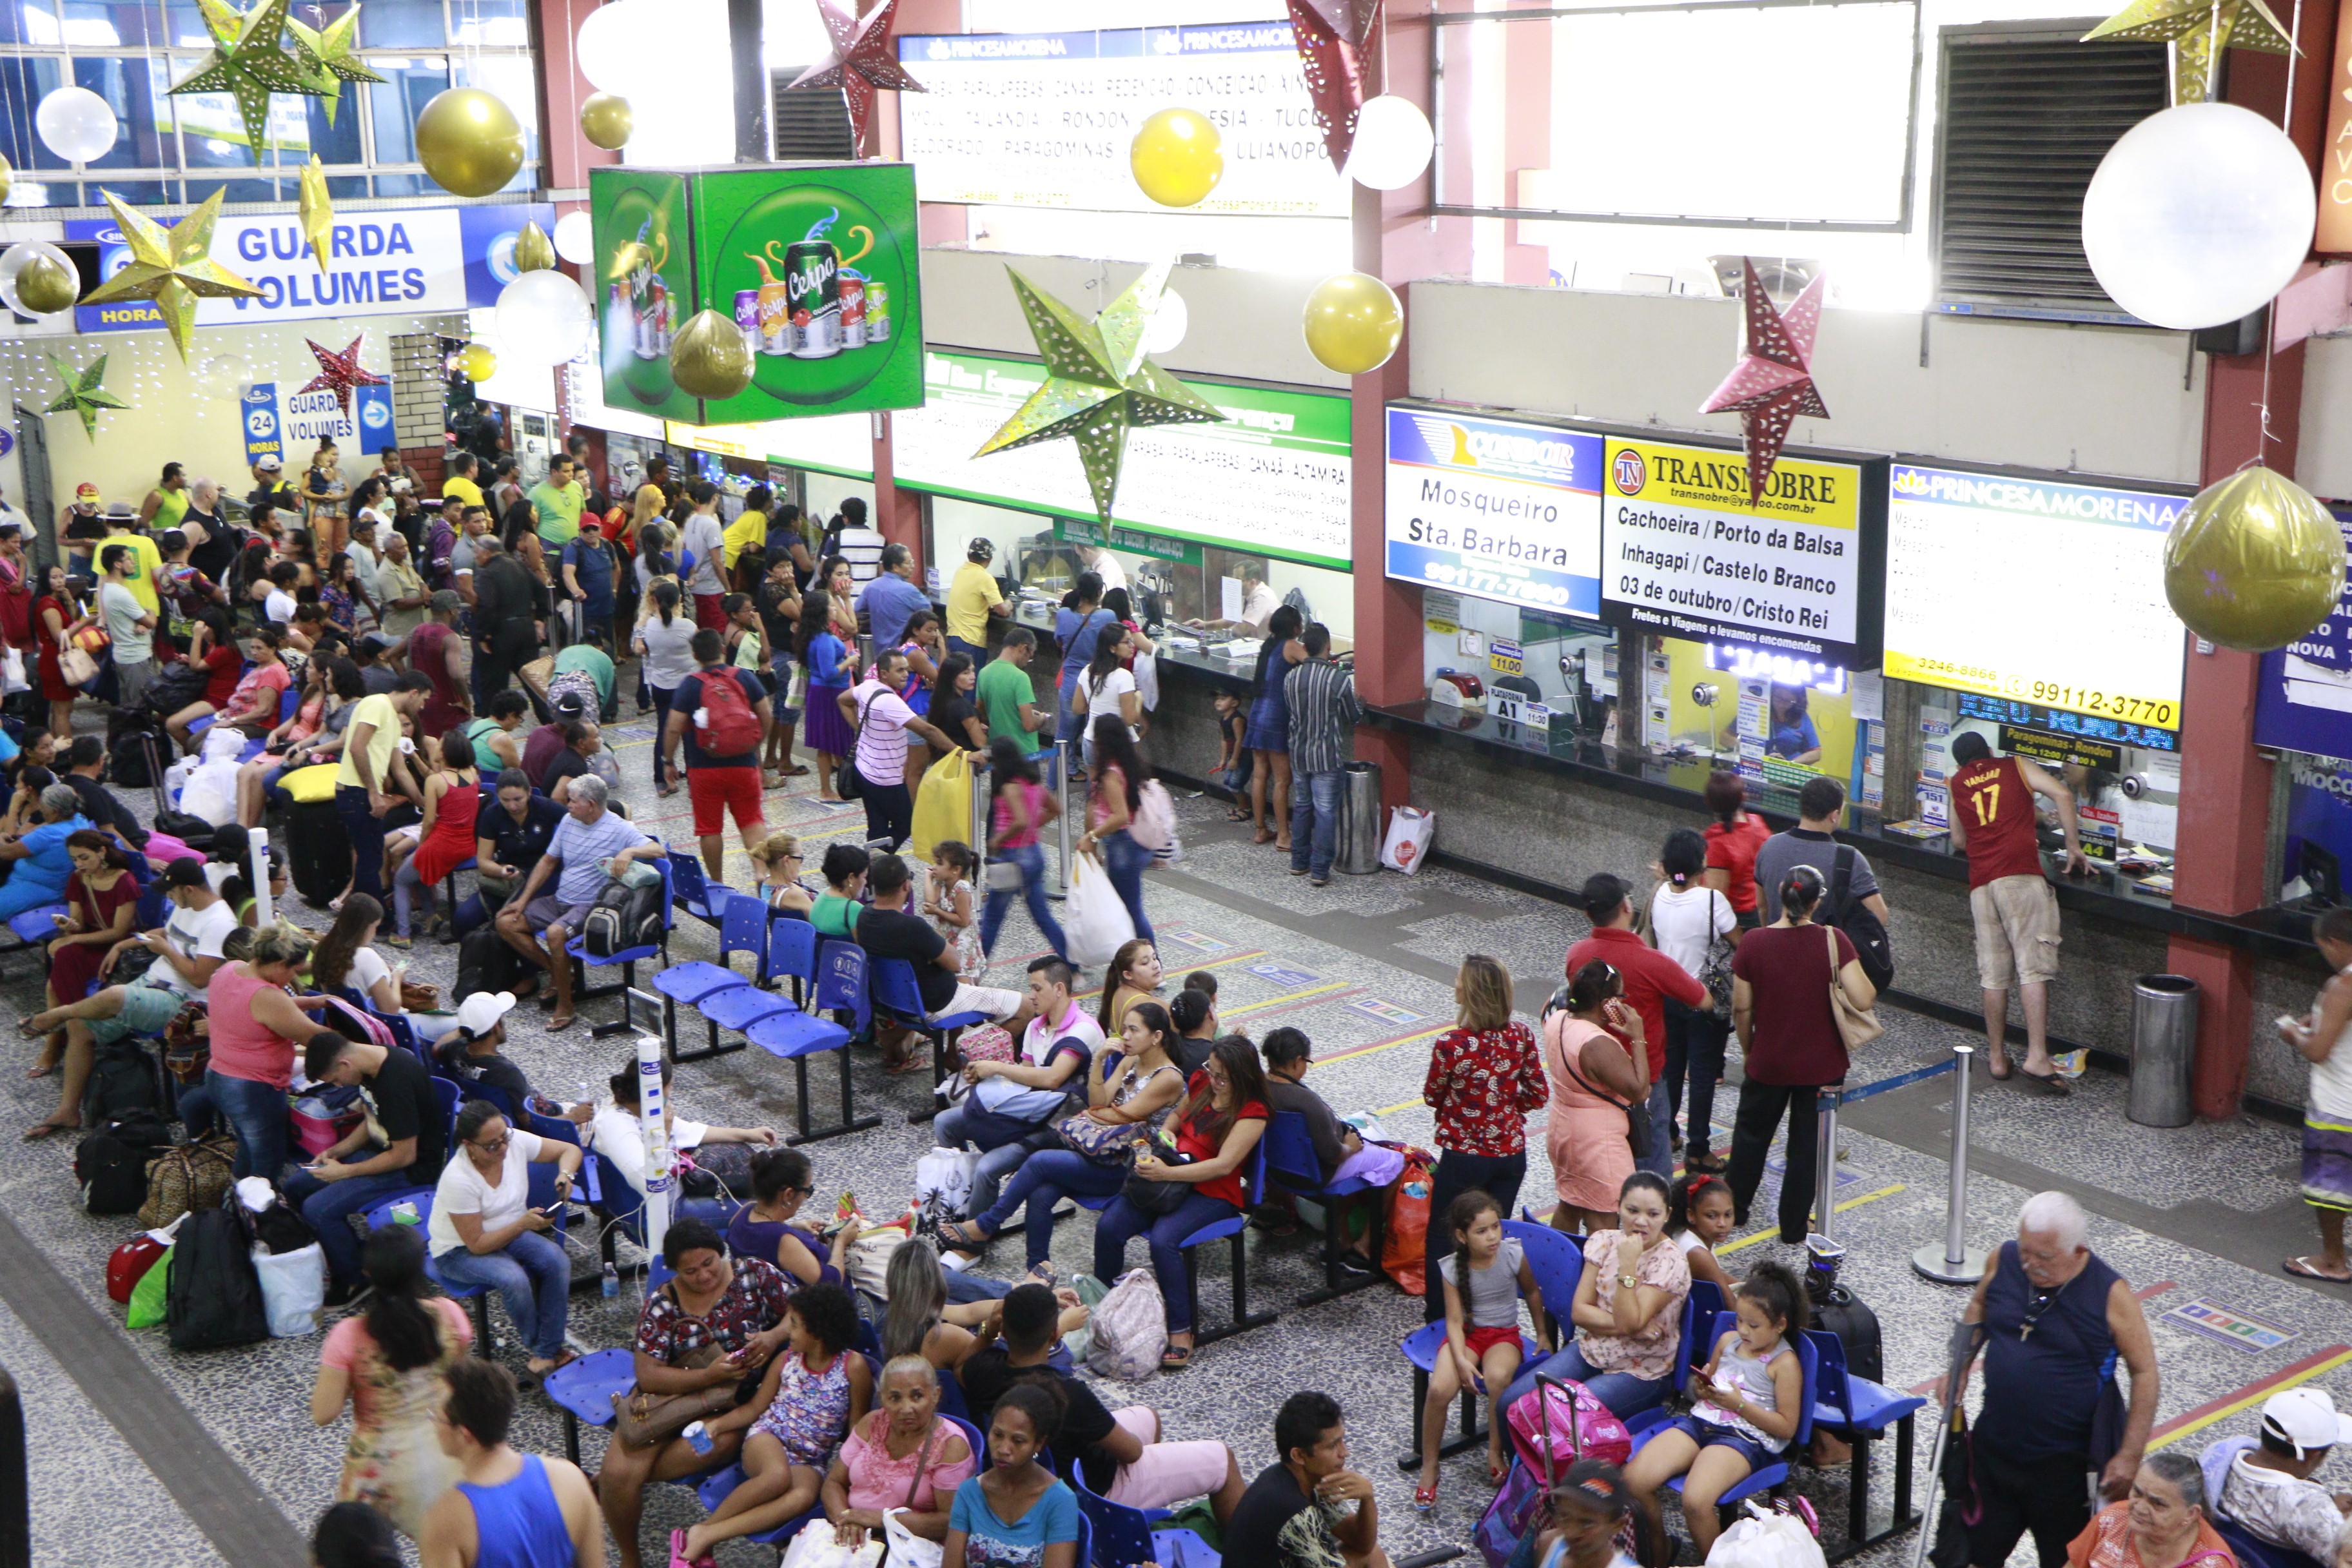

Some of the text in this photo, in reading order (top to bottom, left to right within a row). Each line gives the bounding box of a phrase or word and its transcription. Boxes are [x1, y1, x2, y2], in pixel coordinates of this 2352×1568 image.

[1184, 28, 1297, 50] PRINCESAMOR
[1236, 141, 1329, 161] ULIANOPO
[789, 256, 836, 301] Cerpa
[101, 308, 164, 324] HORA
[252, 416, 273, 431] 24
[288, 418, 353, 440] VOLUMES
[248, 440, 280, 453] HORAS
[1293, 462, 1346, 487] ALTAMIRA
[1616, 458, 1642, 487] TN
[1420, 478, 1558, 524] Mosqueiro
[1671, 487, 1816, 514] transnobre@yaoo.com.br
[1618, 506, 1700, 536] Cachoeira
[1714, 520, 1761, 545] Porto
[1767, 528, 1787, 549] da
[1793, 531, 1844, 557] Balsa
[1621, 542, 1689, 574] Inhagapi
[1703, 555, 1768, 583] Castelo
[1774, 566, 1836, 595] Branco
[1620, 574, 1639, 595] 03
[1644, 580, 1663, 600] de
[1668, 587, 1732, 614] outubro
[1743, 597, 1795, 625] Cristo
[1799, 607, 1829, 631] Rei
[1631, 607, 1661, 623] Fretes
[1662, 616, 1669, 625] e
[1671, 614, 1708, 634] Viagens
[1709, 625, 1716, 635] e
[1716, 623, 1758, 643] levamos
[1758, 631, 1822, 654] encomendas
[1492, 645, 1522, 658] Promoção
[2286, 641, 2336, 660] NOVA
[1918, 657, 1997, 681] 3246-8866
[1491, 688, 1523, 703] PLATAFORMA
[1498, 700, 1516, 719] A1
[1527, 712, 1546, 725] 11:30
[2039, 747, 2061, 760] 12:00
[2074, 740, 2113, 759] Rondon
[1925, 792, 1943, 803] 151
[1970, 783, 2001, 827] 17
[2082, 843, 2105, 857] A4
